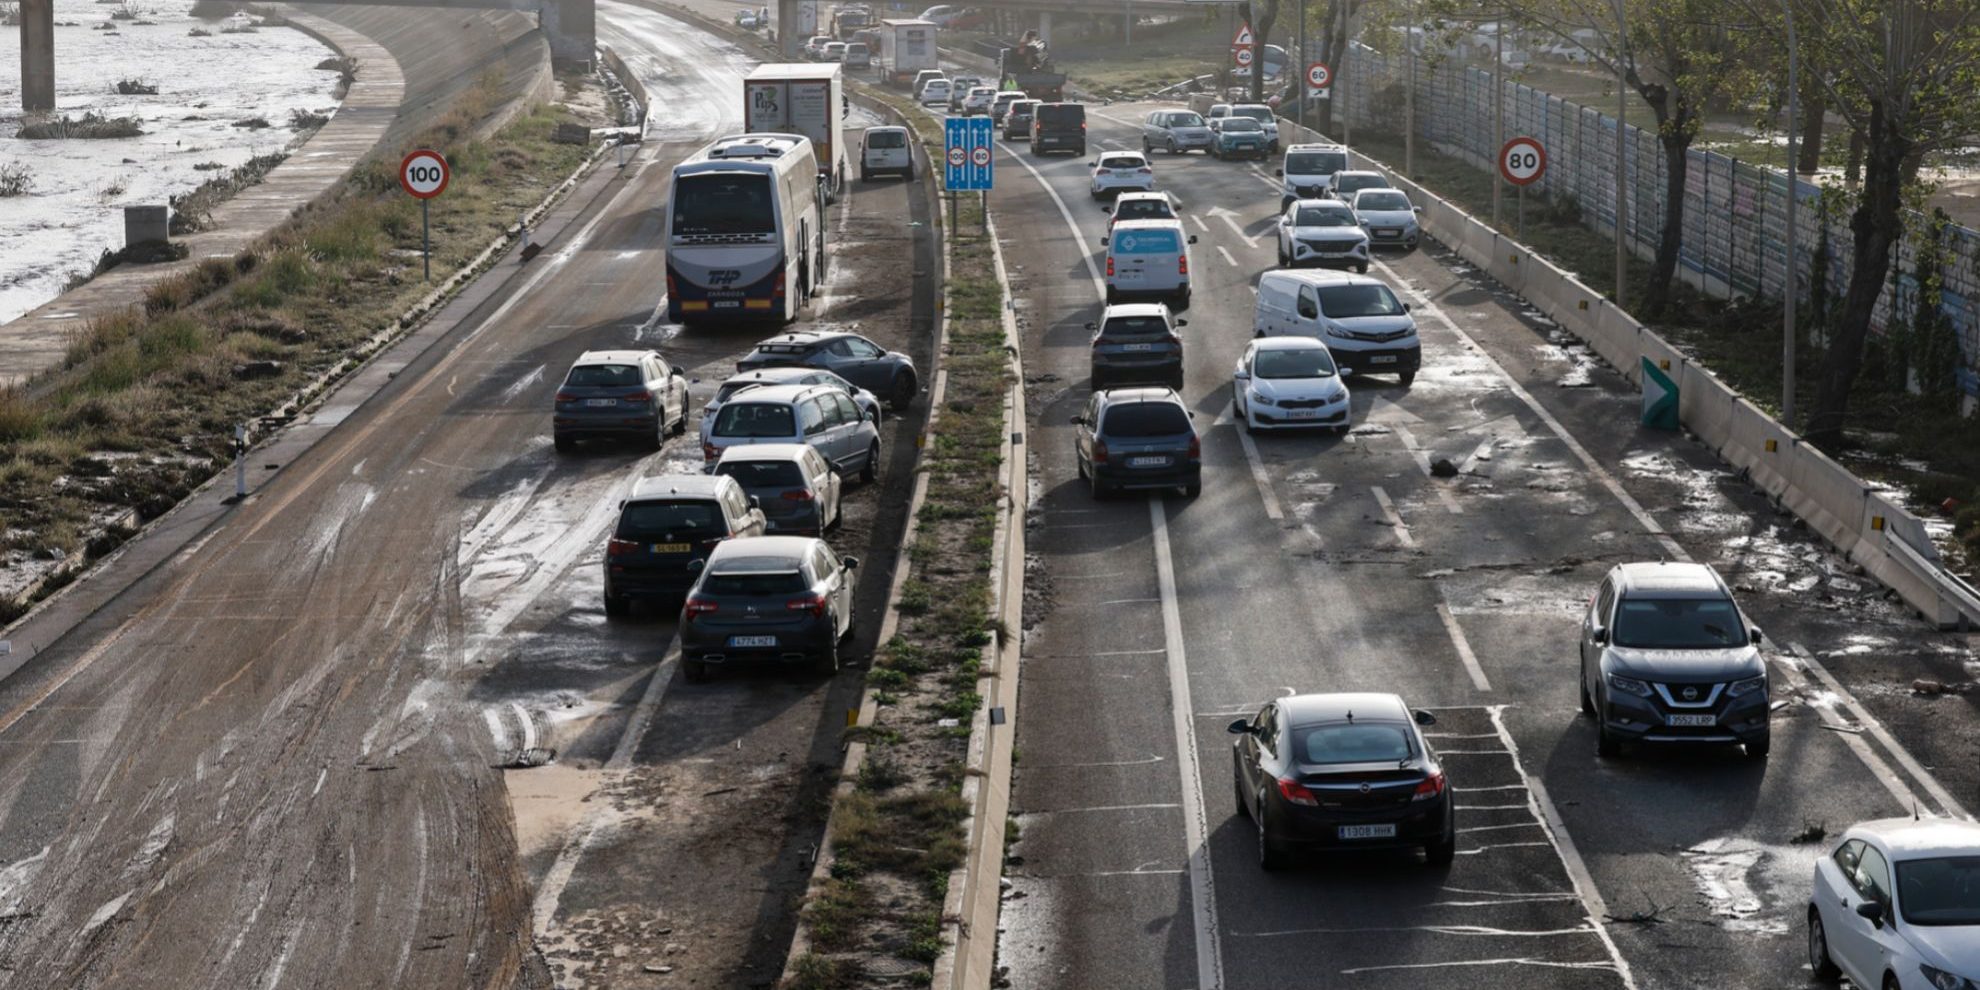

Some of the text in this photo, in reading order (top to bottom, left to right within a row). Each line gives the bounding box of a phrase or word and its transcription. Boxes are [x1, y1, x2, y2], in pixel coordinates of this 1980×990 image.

[1239, 52, 1251, 60] 40
[1312, 71, 1325, 79] 60
[950, 152, 964, 160] 100
[975, 152, 988, 160] 80
[1510, 153, 1536, 169] 80
[409, 166, 441, 183] 100
[1347, 825, 1372, 837] 1308
